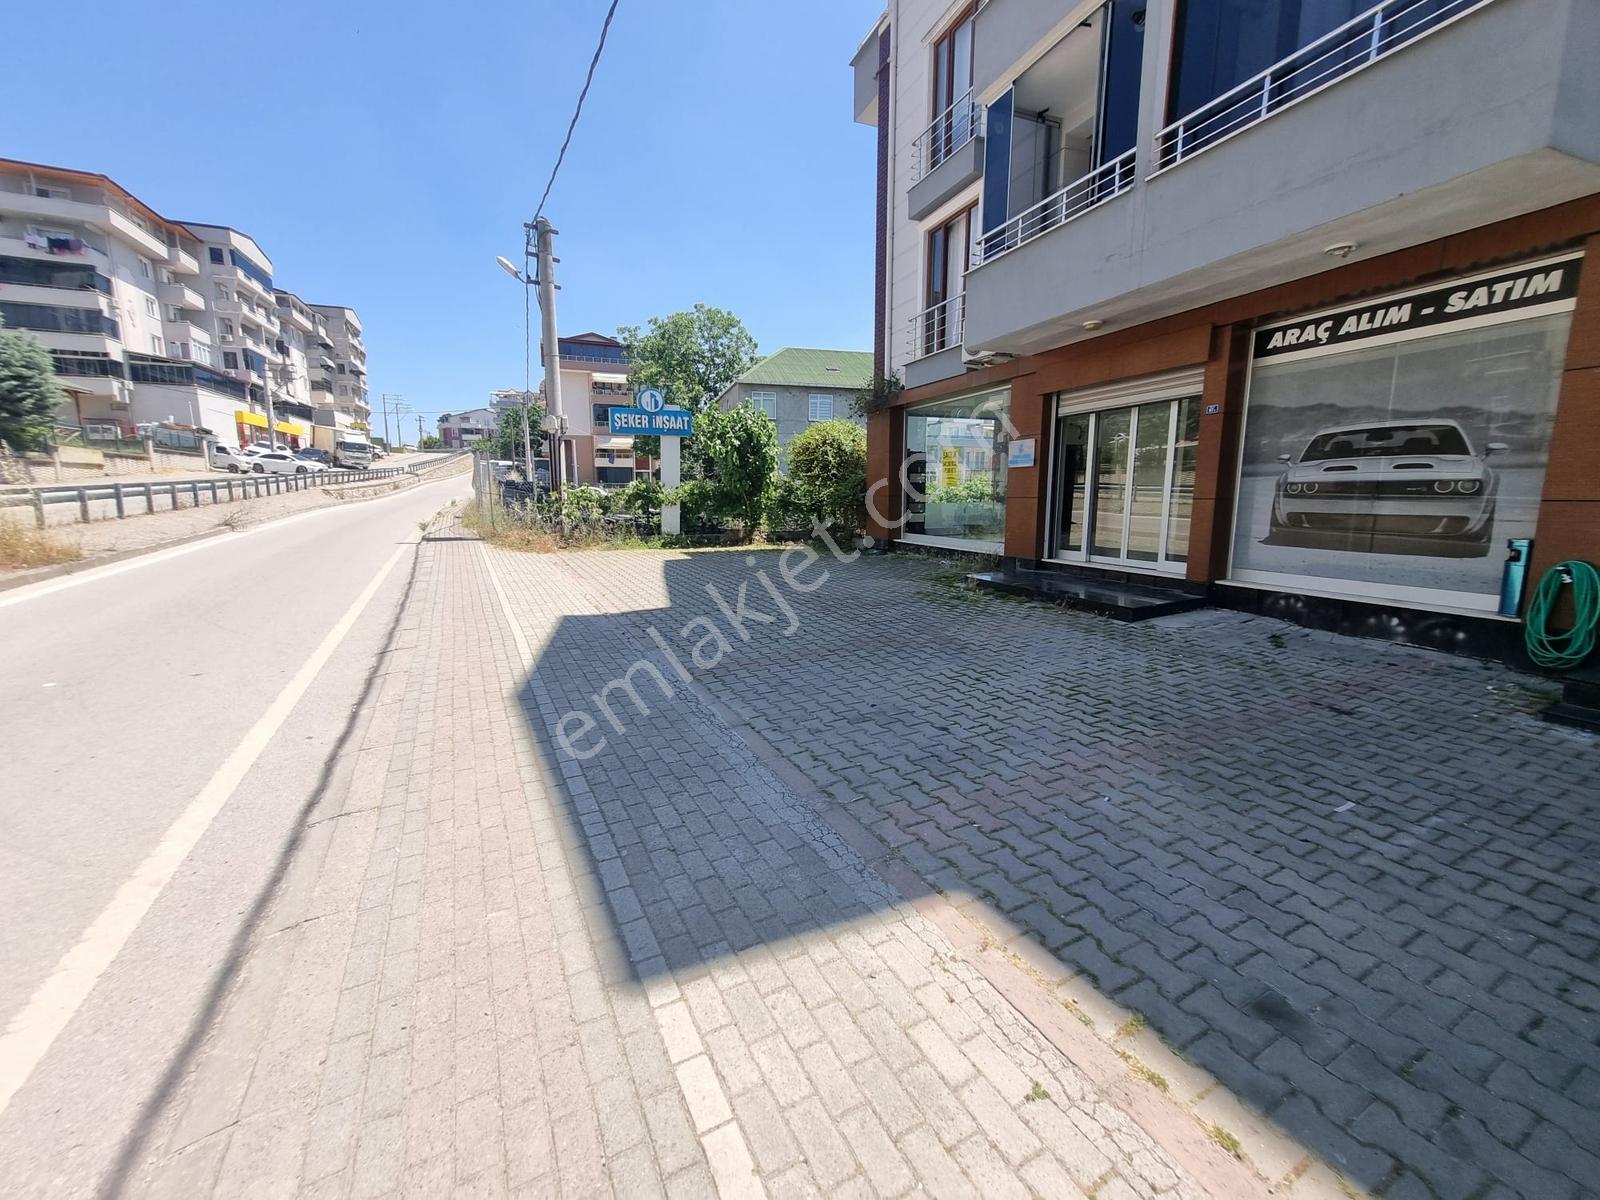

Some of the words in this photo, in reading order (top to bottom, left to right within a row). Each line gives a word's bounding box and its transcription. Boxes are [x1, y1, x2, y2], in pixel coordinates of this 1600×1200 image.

[1267, 321, 1333, 349] ARAÇ
[1338, 303, 1412, 335] ALIM
[1444, 269, 1564, 313] SATIM
[614, 413, 649, 430] ŞEKER
